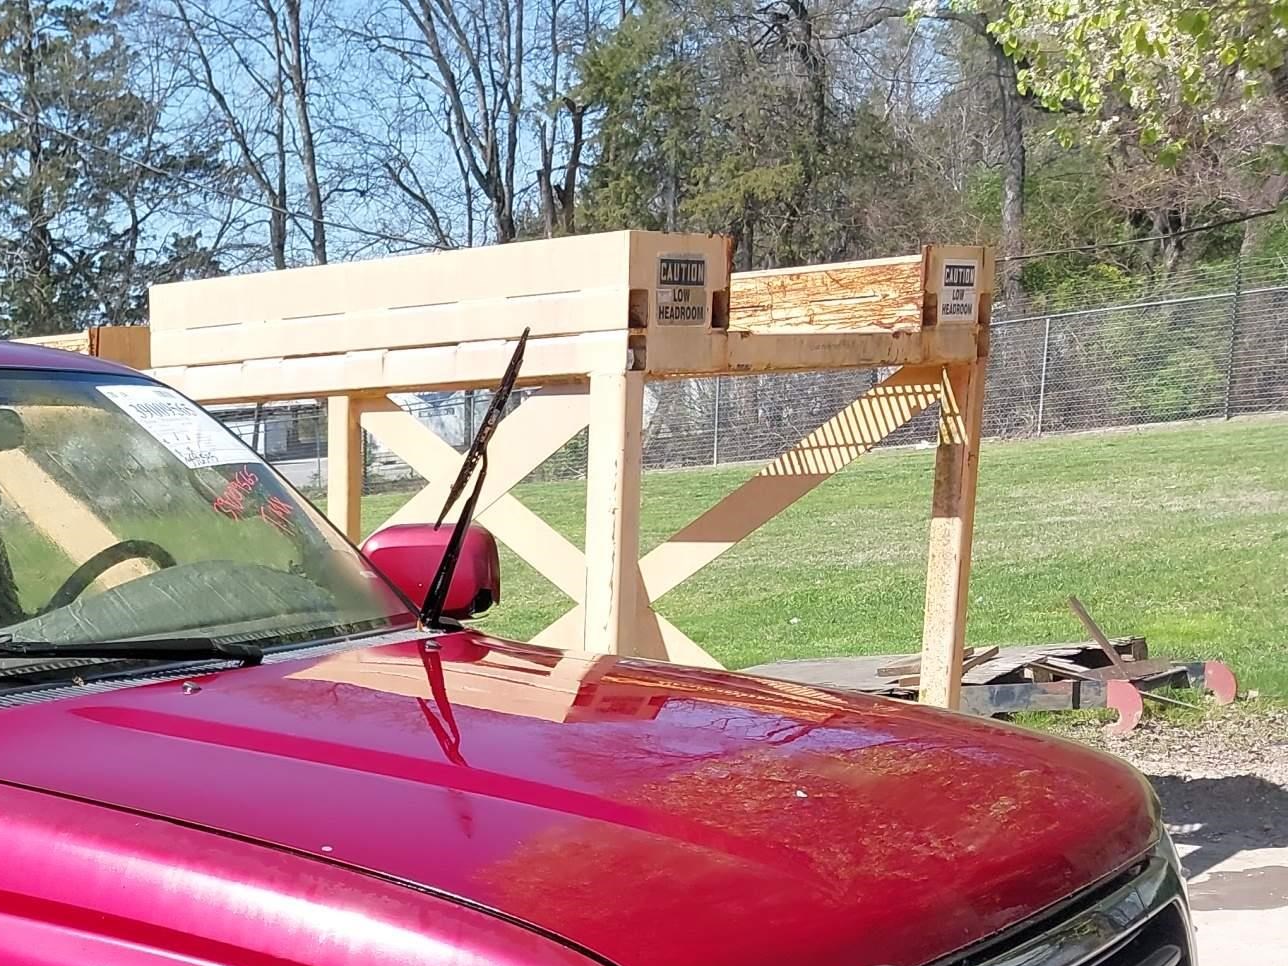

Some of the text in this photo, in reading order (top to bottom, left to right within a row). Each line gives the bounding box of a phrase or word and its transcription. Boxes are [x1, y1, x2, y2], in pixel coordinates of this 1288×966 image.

[661, 262, 704, 282] CAUTION
[945, 268, 975, 284] CAUTION
[673, 288, 691, 302] LOW
[952, 289, 965, 301] LOW
[658, 305, 704, 320] HEADROOM
[942, 303, 973, 316] HEADROOM
